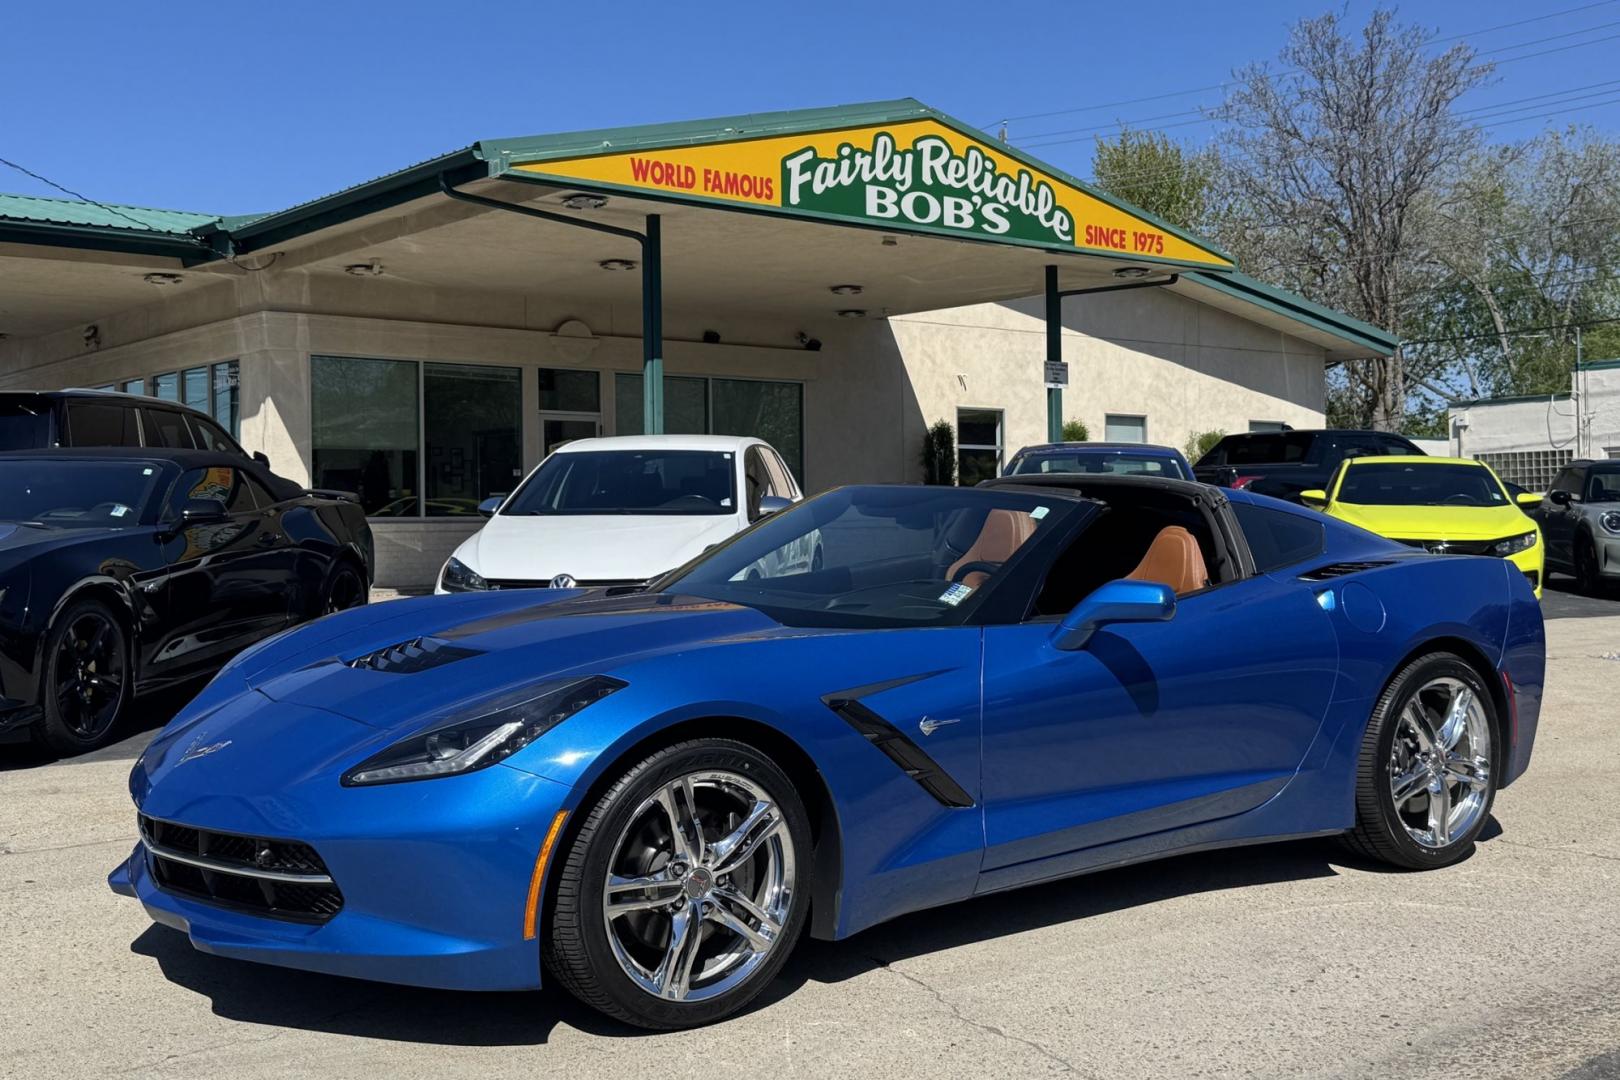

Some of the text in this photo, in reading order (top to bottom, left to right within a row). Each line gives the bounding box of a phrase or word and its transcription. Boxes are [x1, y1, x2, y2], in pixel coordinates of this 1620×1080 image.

[630, 157, 774, 201] WORLD FAMOUS
[786, 135, 1072, 241] Fairly Reliable
[865, 184, 1011, 234] BOB'S
[1085, 224, 1164, 255] SINCE 1975
